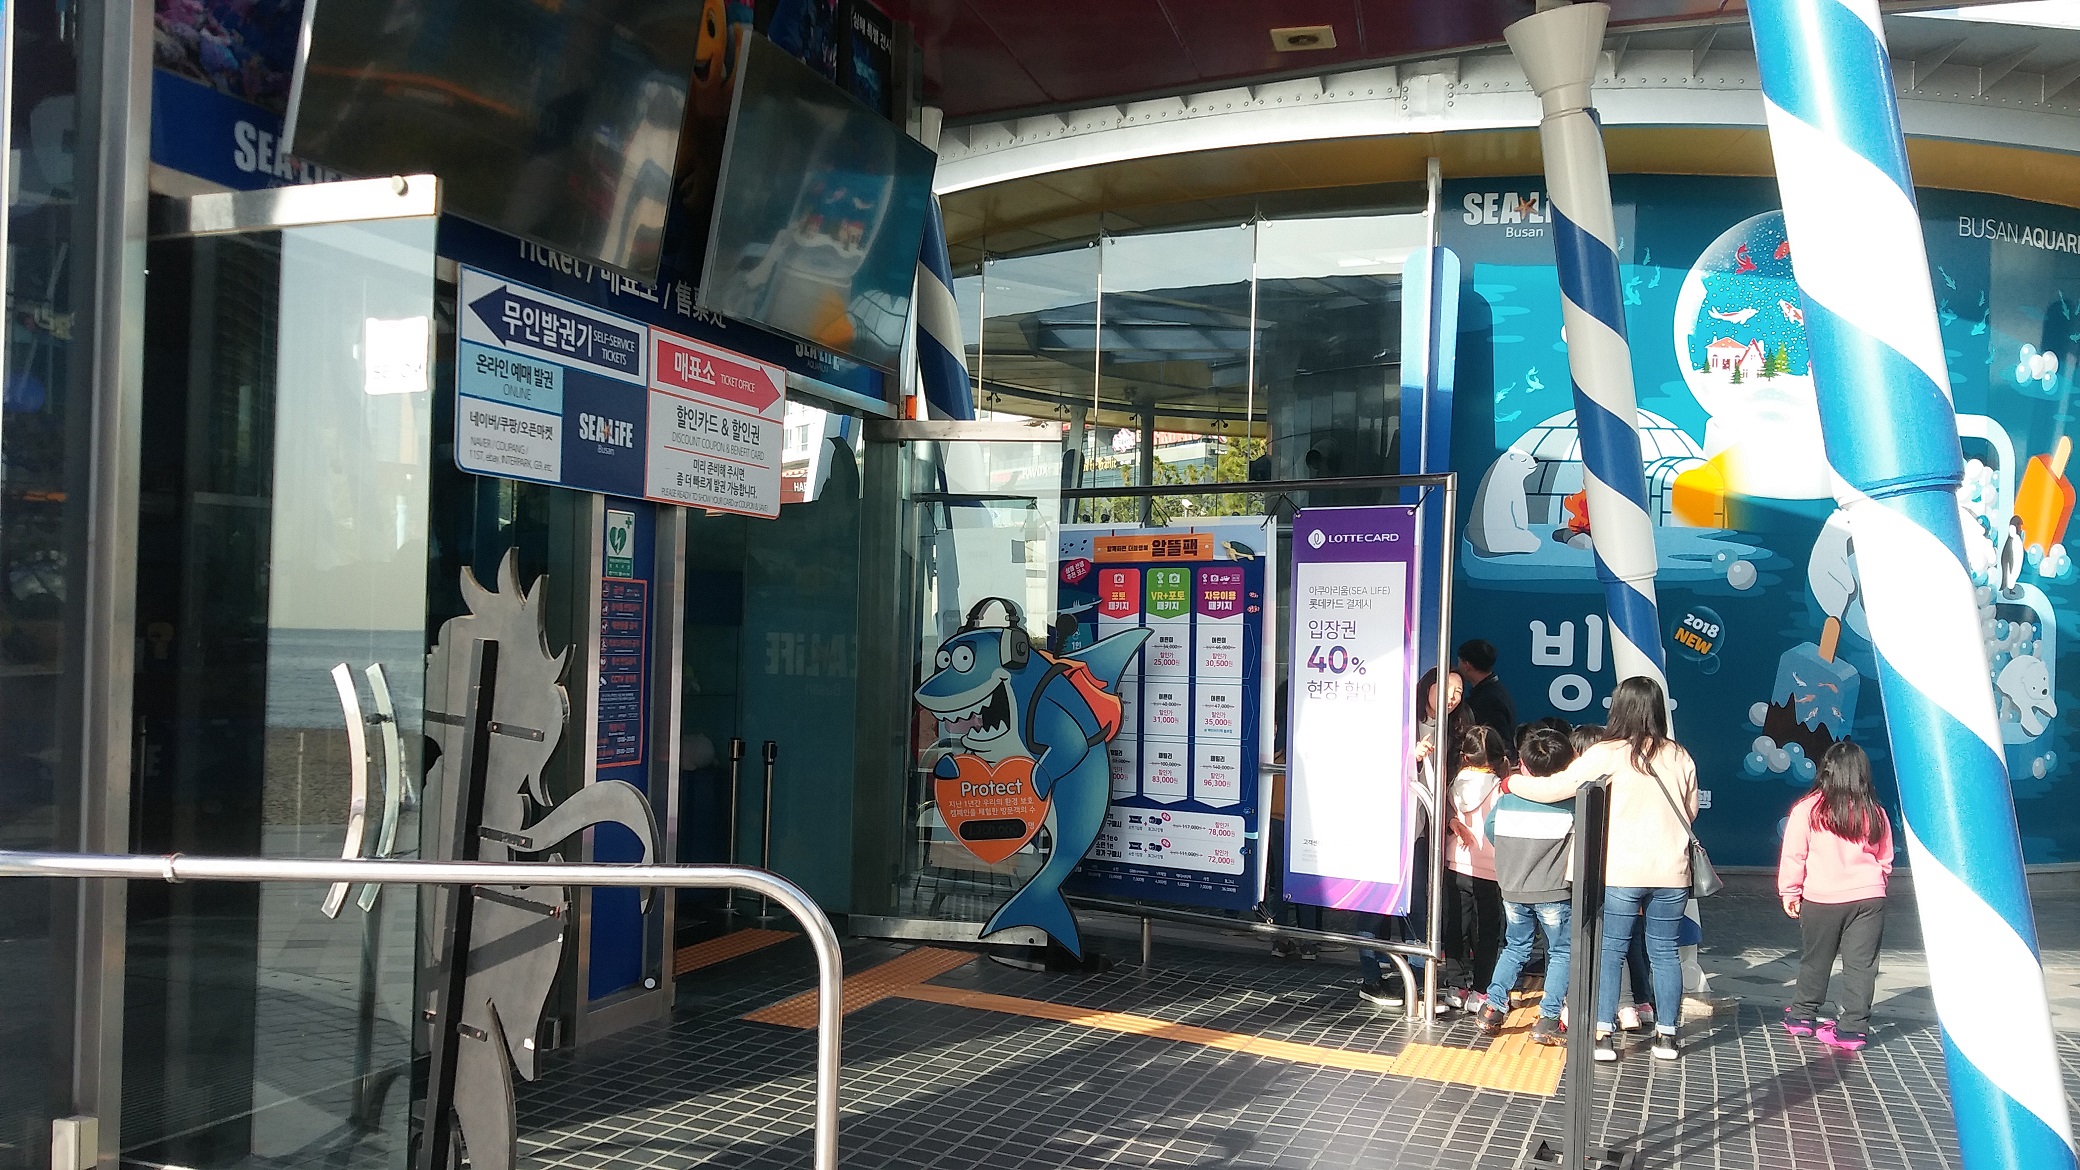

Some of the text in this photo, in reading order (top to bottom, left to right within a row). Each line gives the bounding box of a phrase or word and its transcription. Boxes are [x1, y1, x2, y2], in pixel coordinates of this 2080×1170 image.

[234, 120, 294, 180] SEA
[1463, 192, 1522, 226] SEA
[1505, 226, 1544, 238] Busan
[1959, 216, 2018, 244] BUSAN
[502, 300, 593, 358] 무인발권기
[593, 329, 636, 354] SELF-SERVICE
[601, 347, 628, 366] TICKETS
[476, 353, 554, 390] 온라인 예매 발권
[674, 351, 716, 386] 매표소
[720, 373, 756, 393] TICKET OFFICE
[503, 383, 532, 401] ONLINE
[469, 411, 554, 441] 네이버/쿠팡/오픈마켓
[579, 412, 606, 443] SEA
[677, 405, 761, 446] 할인카드 & 할인권
[597, 445, 615, 456] Busan
[672, 431, 702, 446] DISCOUNT
[701, 436, 726, 453] COUPON
[730, 445, 751, 458] BENEFIT
[750, 449, 765, 461] CARD
[693, 459, 745, 481] 미리 준비해 주시면
[677, 472, 758, 499] 좀 더 빠르게 발권 가능합니다.
[1152, 538, 1198, 557] 알뜰팩
[1111, 592, 1126, 601] 포토
[1150, 591, 1186, 601] VR+포토
[1204, 591, 1237, 601] 자유이용
[1309, 585, 1391, 596] 아쿠아리움(SEA LIFE)
[1108, 601, 1130, 611] 패키지
[1156, 601, 1179, 611] 패키지
[1208, 601, 1232, 611] 패키지
[1309, 598, 1372, 610] 롯데카드 결제시
[1308, 620, 1357, 640] 입장권
[1683, 613, 1720, 639] 2018
[1674, 627, 1713, 655] NEW
[1153, 659, 1180, 667] 25,000원
[1205, 660, 1233, 668] 30,500원
[1307, 645, 1367, 675] 40%
[1307, 680, 1376, 702] 현장 할인
[1153, 716, 1180, 724] 31,000원
[1211, 711, 1226, 719] 할인가
[1204, 718, 1233, 726] 35,000원
[1152, 776, 1178, 785] 83,000원
[1210, 772, 1225, 780] 할인가
[961, 778, 1023, 797] Protect
[1203, 779, 1231, 788] 96,300원
[948, 796, 1035, 809] 지난 1년간 우리의 환경 보호
[950, 808, 976, 818] 캠페인을
[1000, 806, 1027, 816] 방문객의
[1029, 805, 1036, 814] 수
[1028, 821, 1035, 830] 명
[1215, 821, 1230, 829] 할인가
[1208, 828, 1236, 837] 78,000원
[1207, 856, 1235, 865] 72,000원
